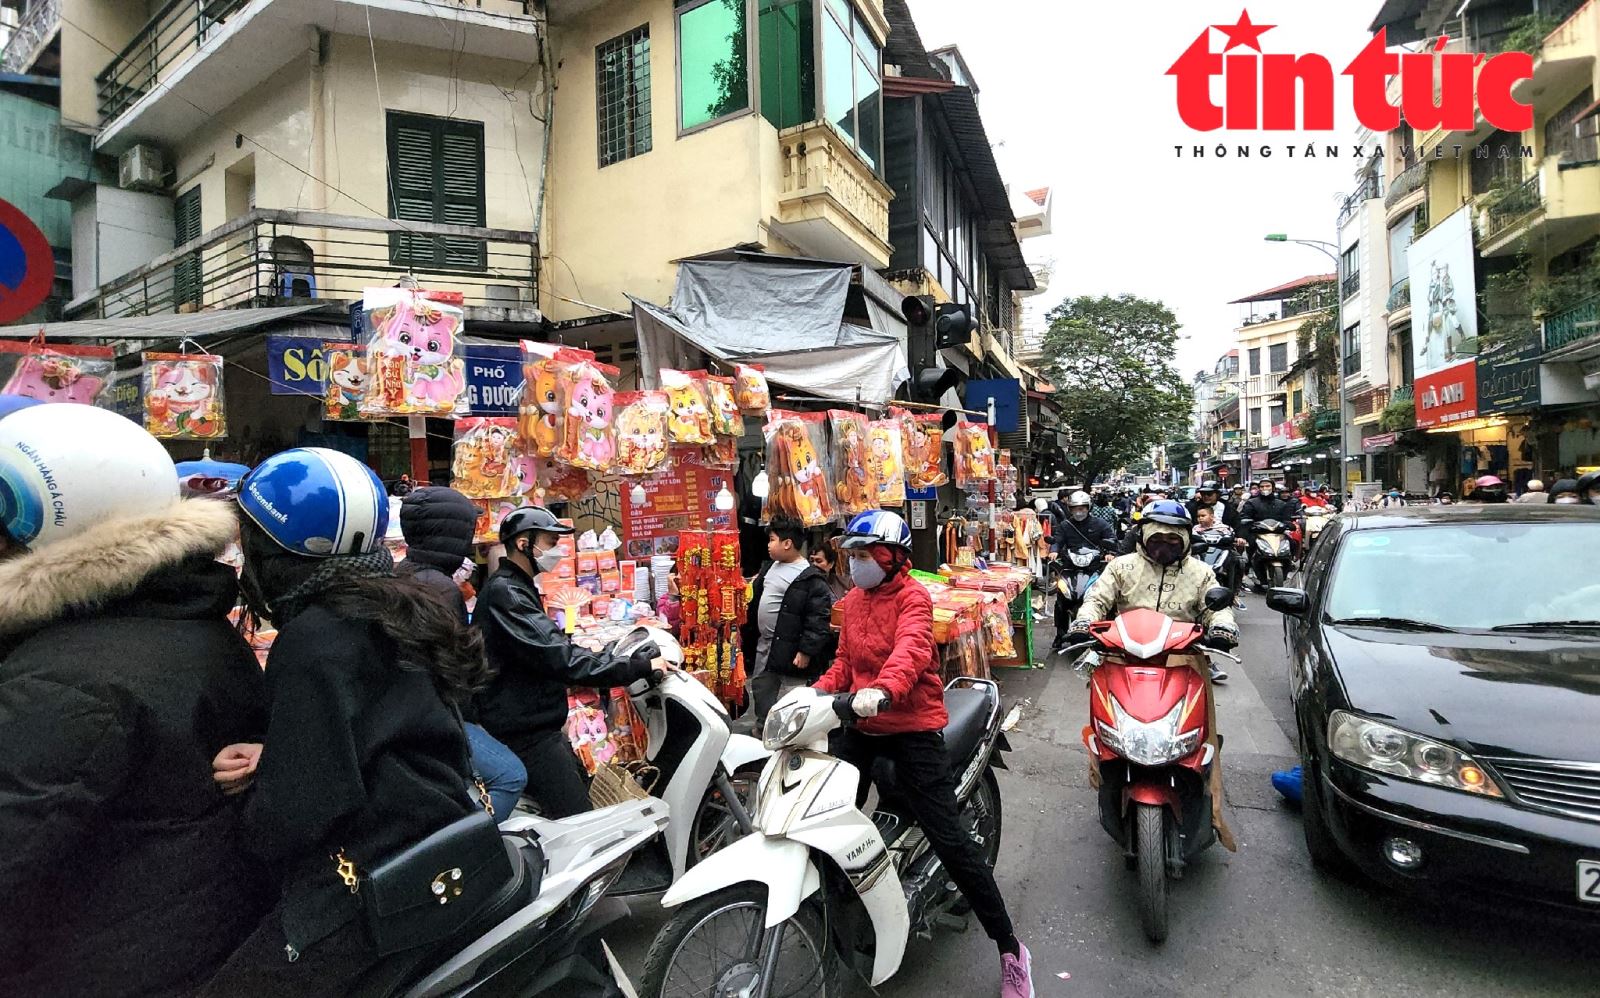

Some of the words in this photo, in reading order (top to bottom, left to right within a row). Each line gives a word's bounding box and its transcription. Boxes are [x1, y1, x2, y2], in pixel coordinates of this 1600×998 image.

[473, 364, 505, 379] PHỐ
[1421, 384, 1440, 410] HÀ
[1440, 381, 1465, 406] ANH
[16, 441, 41, 463] NGÂN
[36, 462, 57, 491] HÀNG
[53, 500, 67, 527] CHÂU
[248, 482, 288, 523] Sacombank
